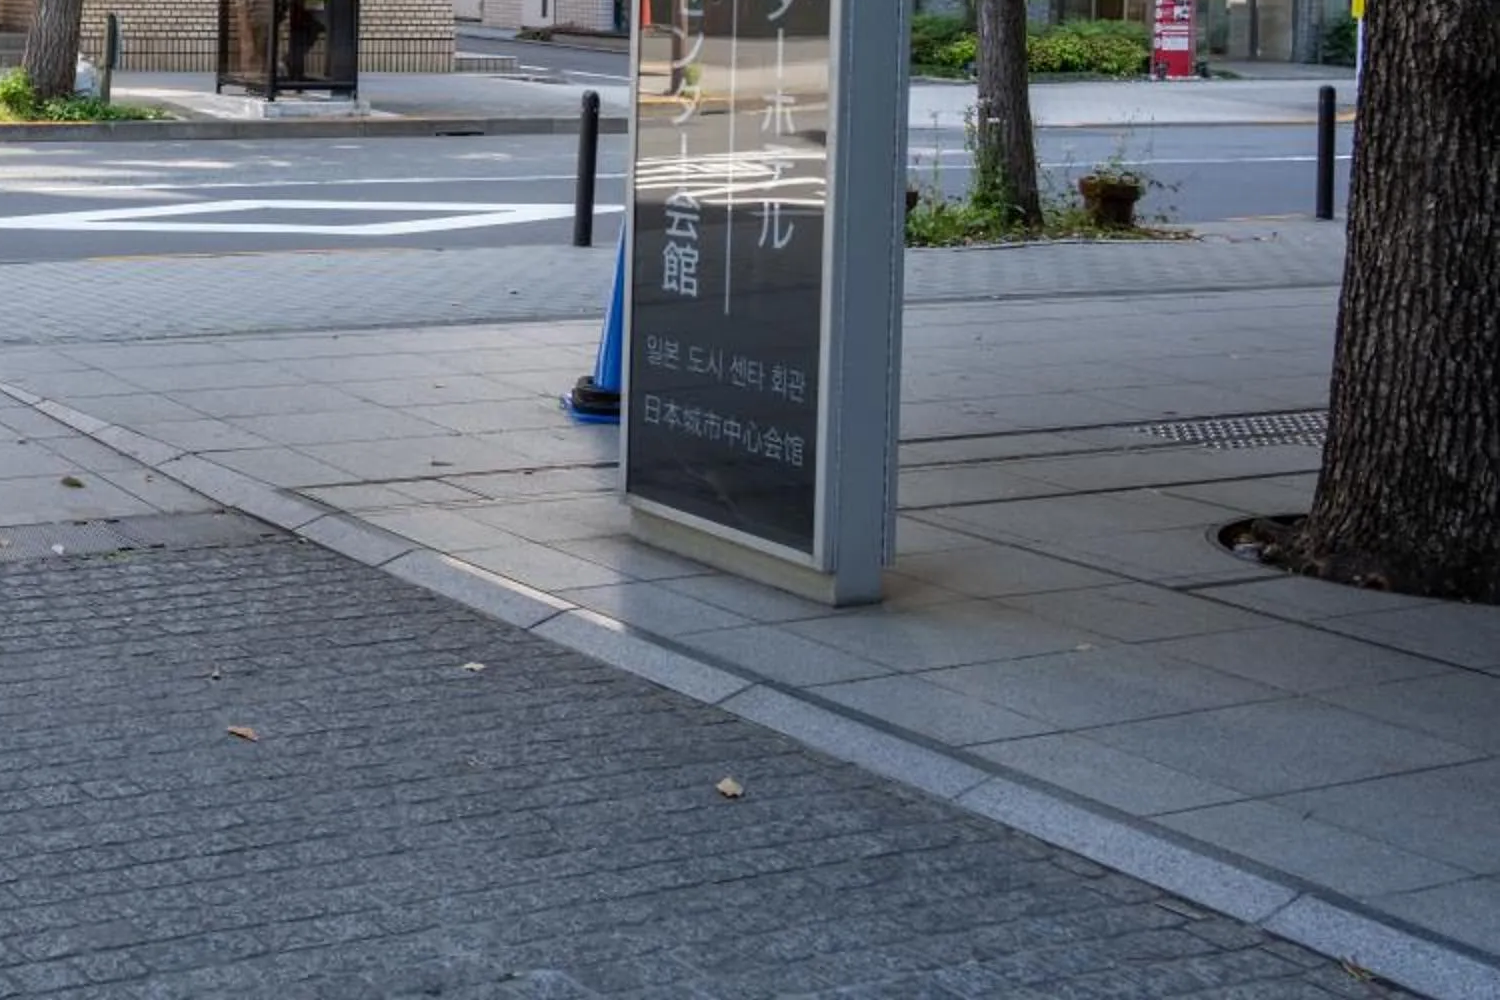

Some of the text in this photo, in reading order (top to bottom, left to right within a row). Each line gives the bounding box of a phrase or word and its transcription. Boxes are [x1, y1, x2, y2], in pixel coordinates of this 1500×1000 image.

[646, 335, 806, 403] 일본 도시 센타 회관
